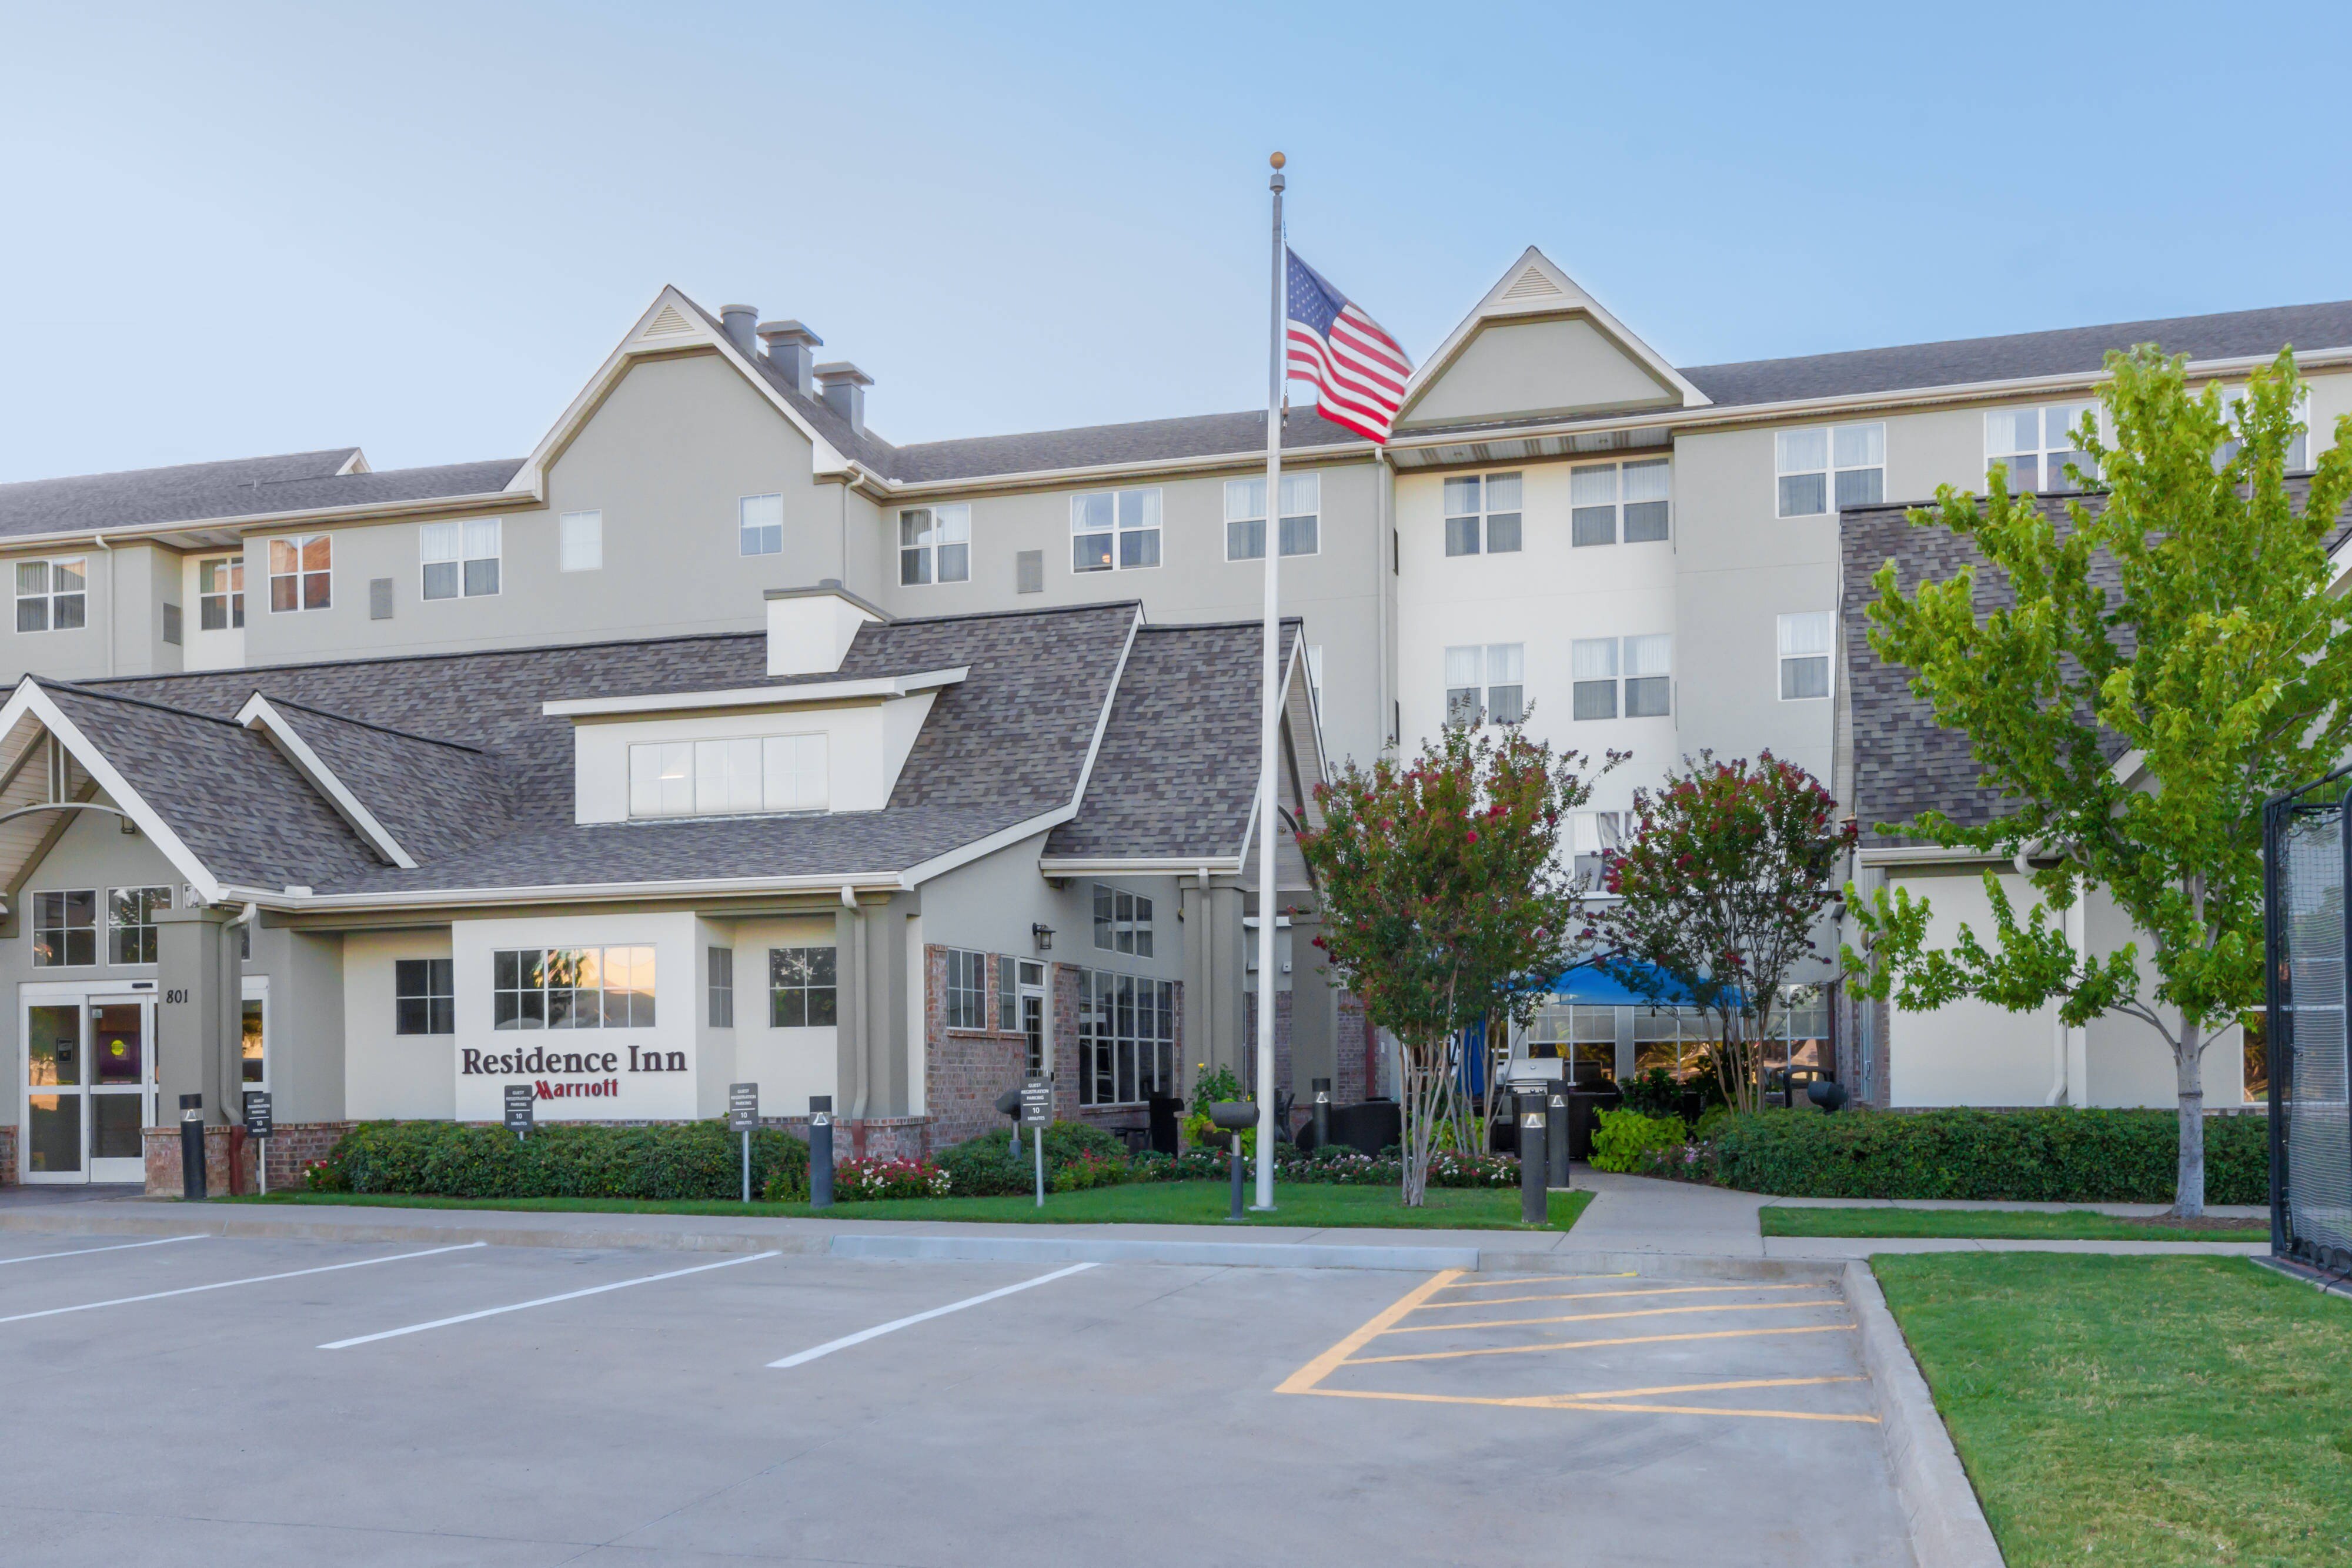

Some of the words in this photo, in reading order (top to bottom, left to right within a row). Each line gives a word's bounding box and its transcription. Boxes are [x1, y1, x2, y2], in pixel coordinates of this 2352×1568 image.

[166, 989, 188, 1004] 801
[461, 1046, 618, 1075] Residence
[627, 1045, 688, 1072] Inn
[532, 1078, 619, 1101] Marriott
